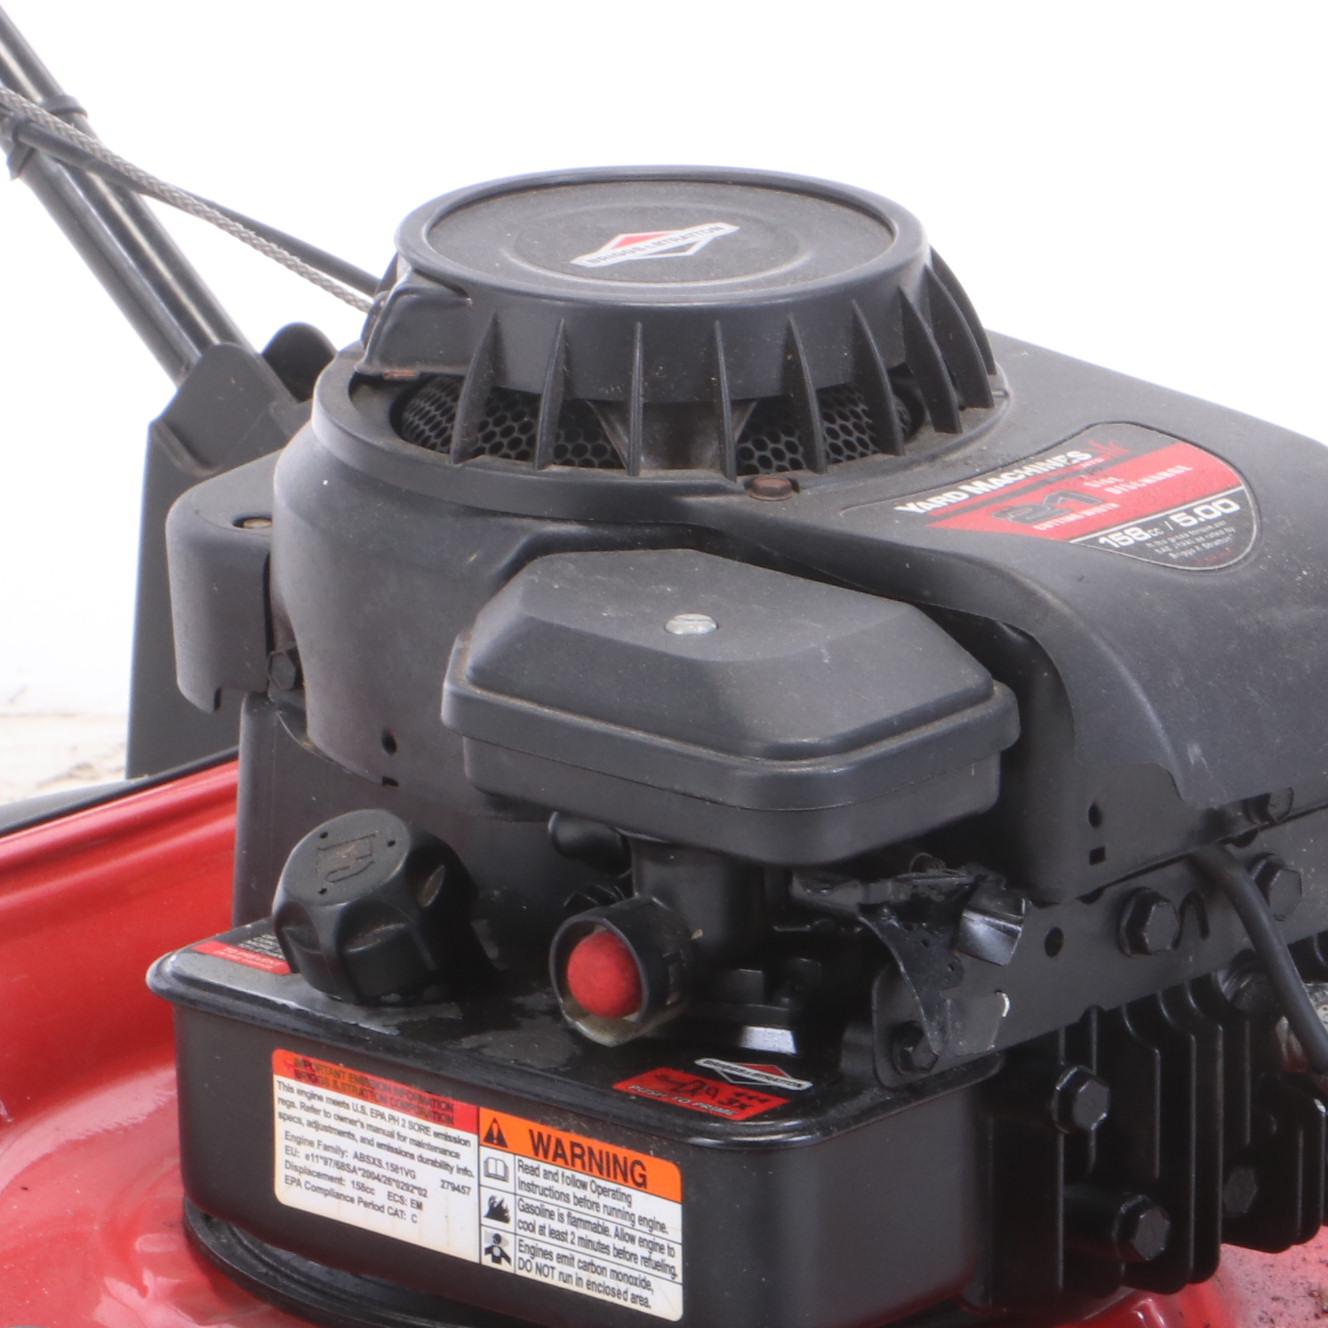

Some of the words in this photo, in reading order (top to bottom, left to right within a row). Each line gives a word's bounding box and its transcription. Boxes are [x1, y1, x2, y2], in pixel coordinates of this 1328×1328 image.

[894, 486, 970, 516] YARD
[971, 450, 1092, 497] MACHINES
[1169, 498, 1241, 528] 5.00
[277, 1079, 294, 1093] This
[296, 1087, 323, 1104] engine
[325, 1095, 349, 1110] meets
[352, 1103, 367, 1116] U.S.
[370, 1108, 386, 1121] EPA
[387, 1114, 399, 1125] PH
[433, 1128, 470, 1148] emission
[672, 1094, 691, 1104] TO
[284, 1129, 314, 1149] Engine
[317, 1139, 347, 1159] Family:
[285, 1144, 300, 1158] EU:
[300, 1101, 321, 1116] Refer
[323, 1109, 331, 1119] to
[366, 1122, 394, 1139] manual
[396, 1131, 406, 1143] for
[409, 1136, 459, 1160] maintenance
[359, 1134, 374, 1147] and
[376, 1139, 414, 1160] emissions
[417, 1152, 453, 1174] durability
[517, 1158, 540, 1177] Read
[543, 1165, 558, 1183] and
[561, 1171, 586, 1191] follow
[590, 1179, 632, 1208] Operating
[528, 1126, 647, 1190] WARNING
[284, 1159, 345, 1189] Displacement:
[387, 1191, 407, 1206] ECS:
[410, 1198, 422, 1211] EM
[284, 1174, 301, 1189] EPA
[304, 1179, 354, 1207] Compliance
[357, 1196, 384, 1214] Period
[387, 1205, 406, 1220] CAT:
[411, 1214, 417, 1224] C
[518, 1176, 570, 1205] Instructions
[572, 1193, 600, 1213] before
[602, 1202, 635, 1226] running
[637, 1212, 668, 1237] engine.
[517, 1197, 554, 1221] Gasoline
[557, 1209, 564, 1224] is
[566, 1212, 611, 1238] flammable.
[614, 1226, 635, 1245] Allow
[638, 1234, 664, 1257] engine
[666, 1244, 675, 1258] to
[517, 1216, 535, 1234] cool
[538, 1223, 546, 1236] at
[548, 1225, 568, 1243] least
[570, 1232, 575, 1245] 2
[577, 1234, 609, 1255] minutes
[613, 1245, 638, 1264] before
[518, 1238, 553, 1265] Engines
[556, 1250, 575, 1268] emit
[577, 1256, 606, 1277] carbon
[518, 1256, 532, 1273] DO
[535, 1261, 555, 1280] NOT
[558, 1270, 572, 1284] run
[575, 1273, 583, 1288] in
[586, 1277, 627, 1302] enclosed
[630, 1292, 651, 1309] area.
